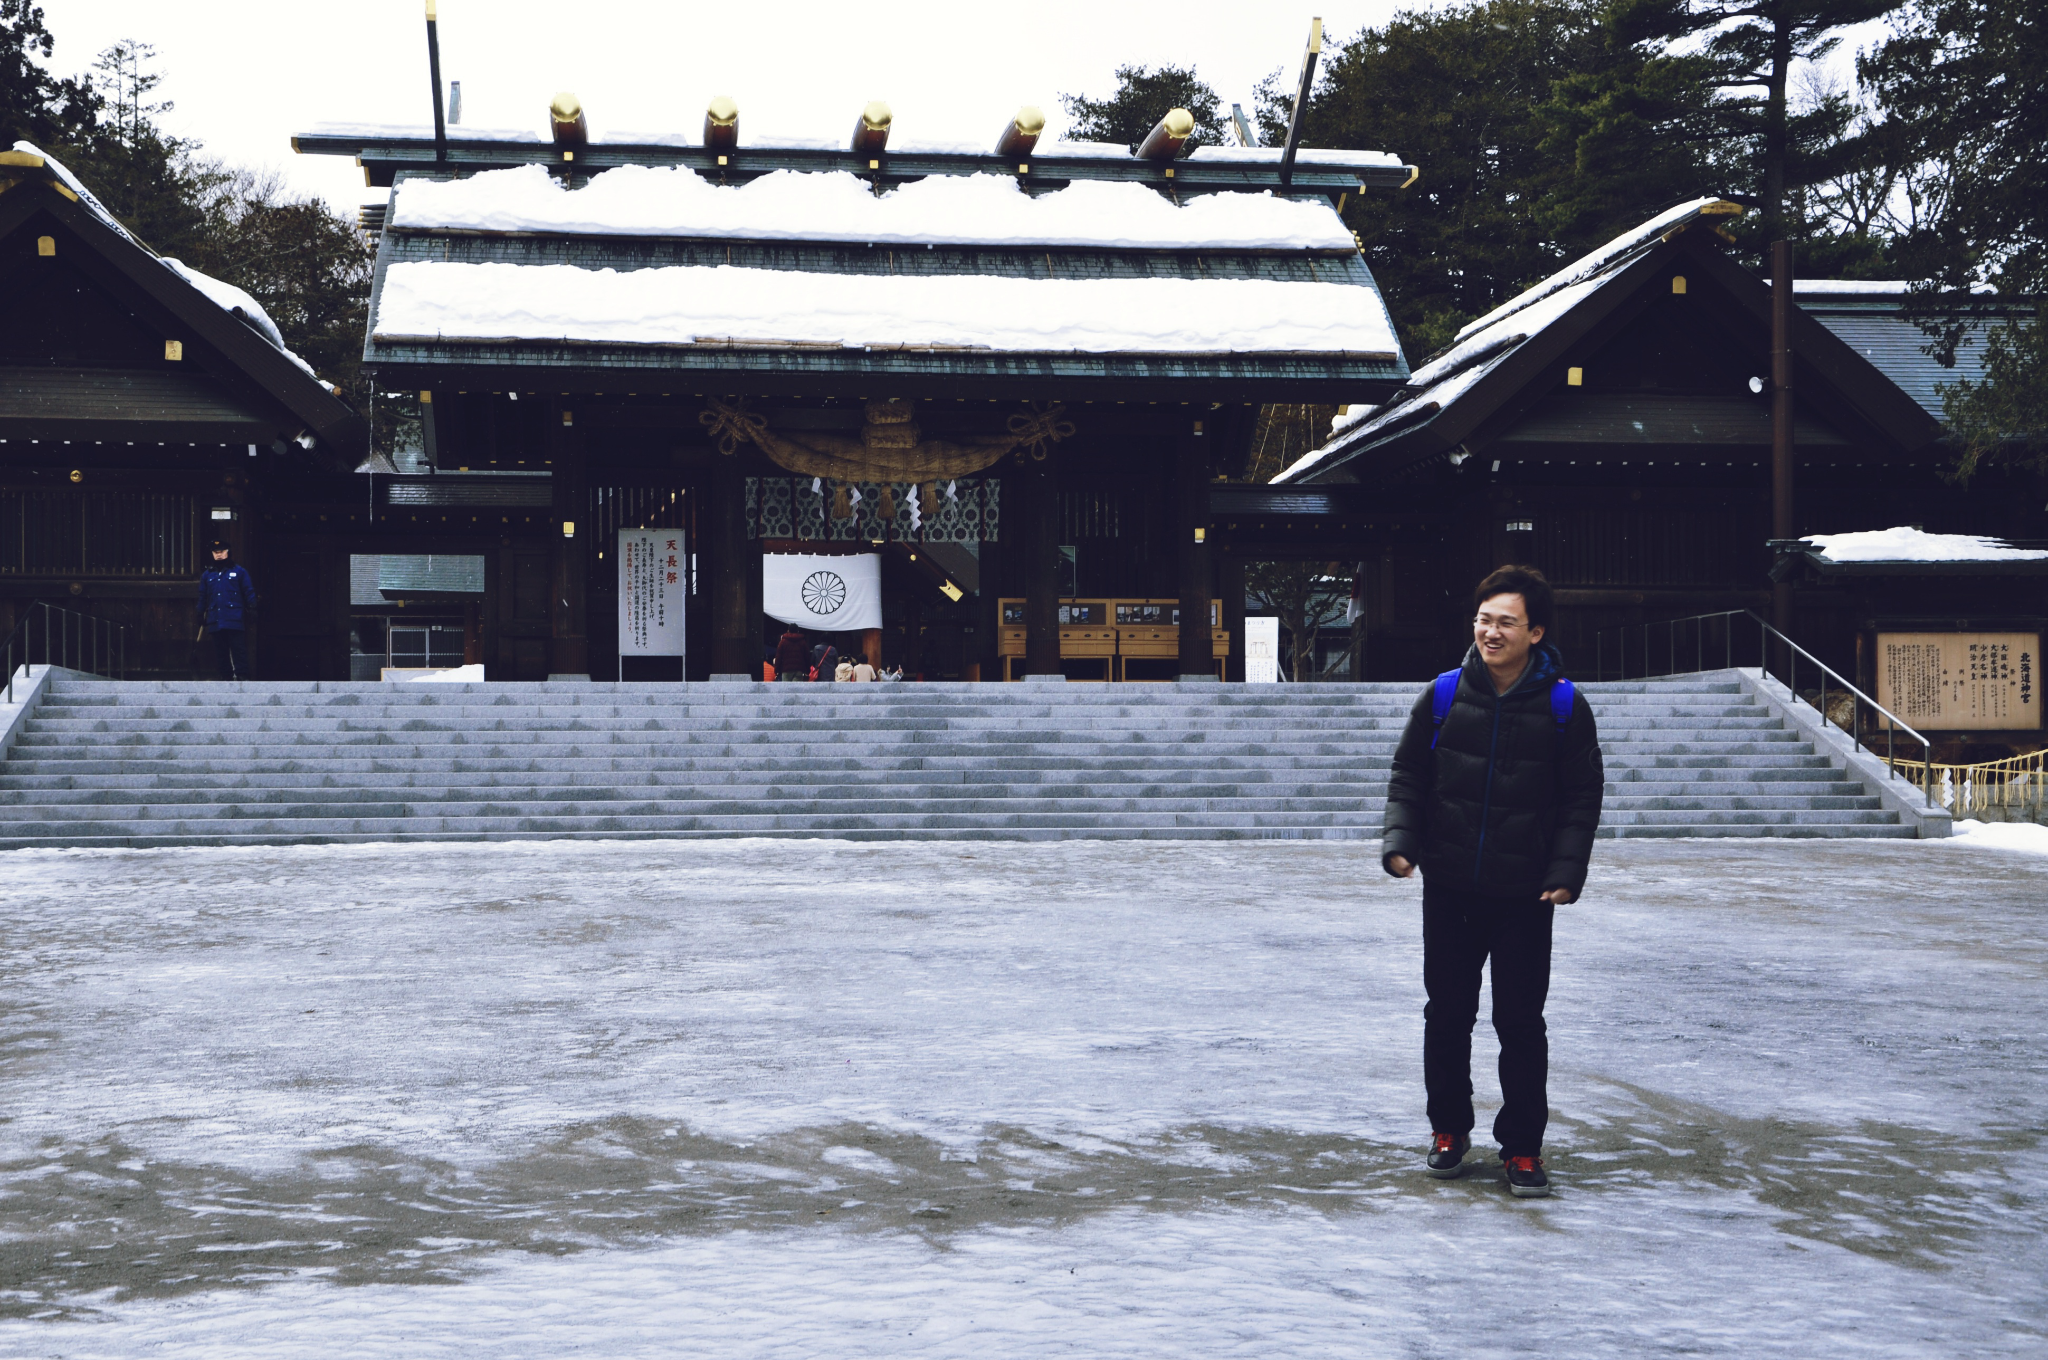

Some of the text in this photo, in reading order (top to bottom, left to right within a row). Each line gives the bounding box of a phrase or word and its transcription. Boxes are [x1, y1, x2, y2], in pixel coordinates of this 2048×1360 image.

[666, 539, 678, 584] 天長祭
[1969, 644, 1977, 681] 明治天皇
[1980, 644, 1988, 680] 少彦名神
[2000, 644, 2008, 680] 大国魂神
[2020, 652, 2031, 704] 北海道神宮
